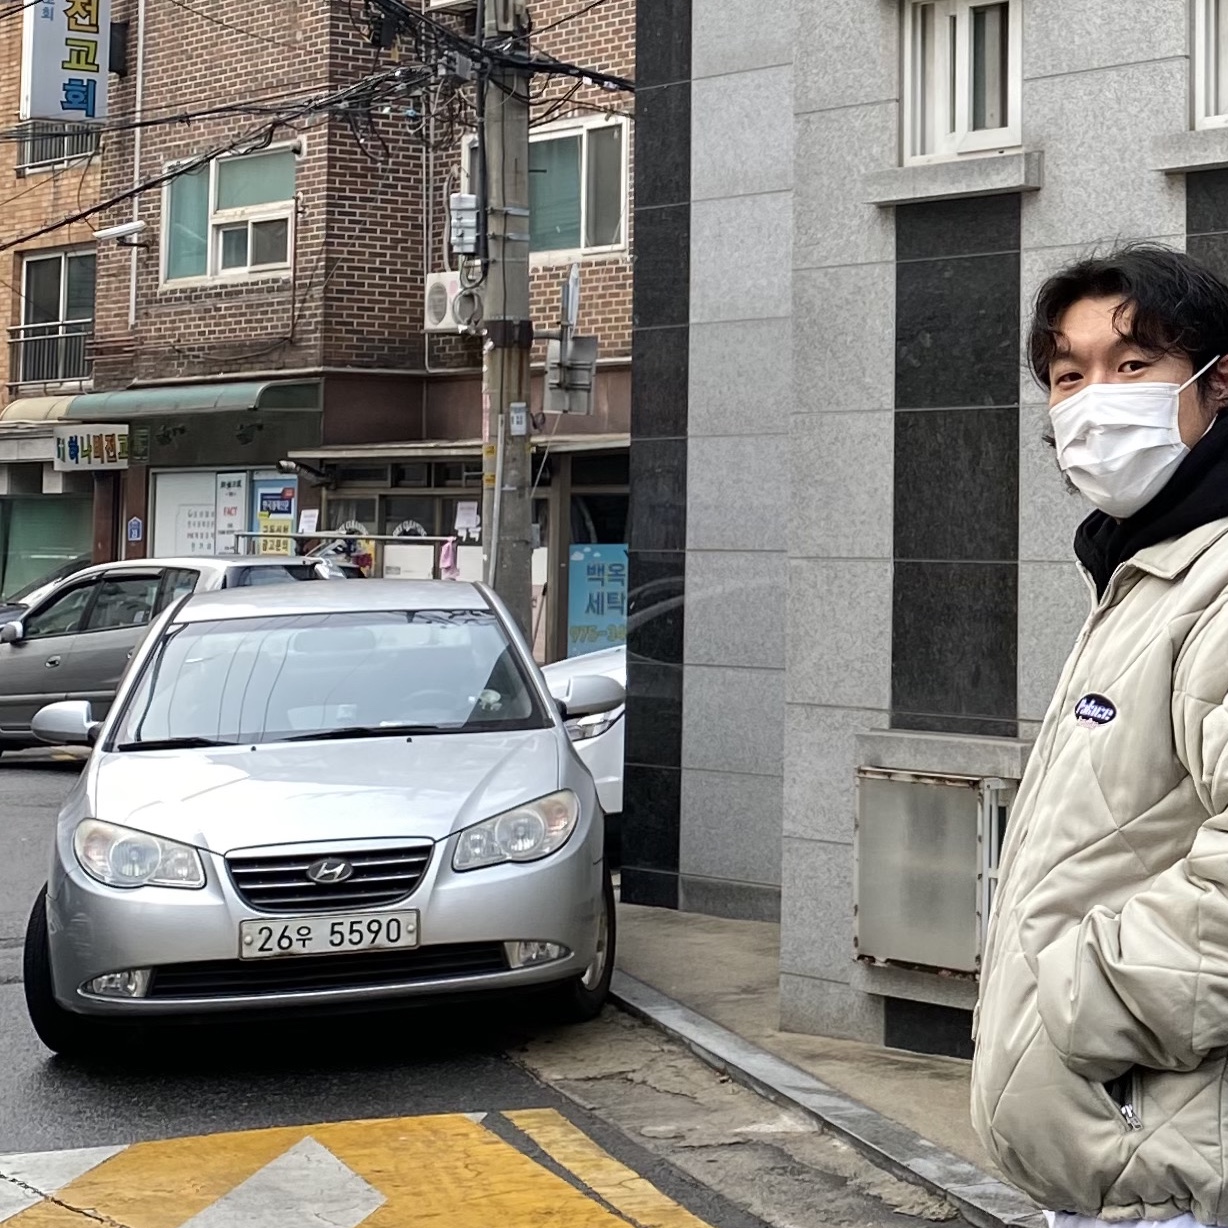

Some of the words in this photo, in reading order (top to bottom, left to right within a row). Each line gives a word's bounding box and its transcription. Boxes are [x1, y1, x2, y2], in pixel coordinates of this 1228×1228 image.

[587, 563, 625, 587] 백옥
[585, 591, 625, 616] 세탁
[258, 925, 313, 952] 26우
[329, 918, 401, 947] 5590
